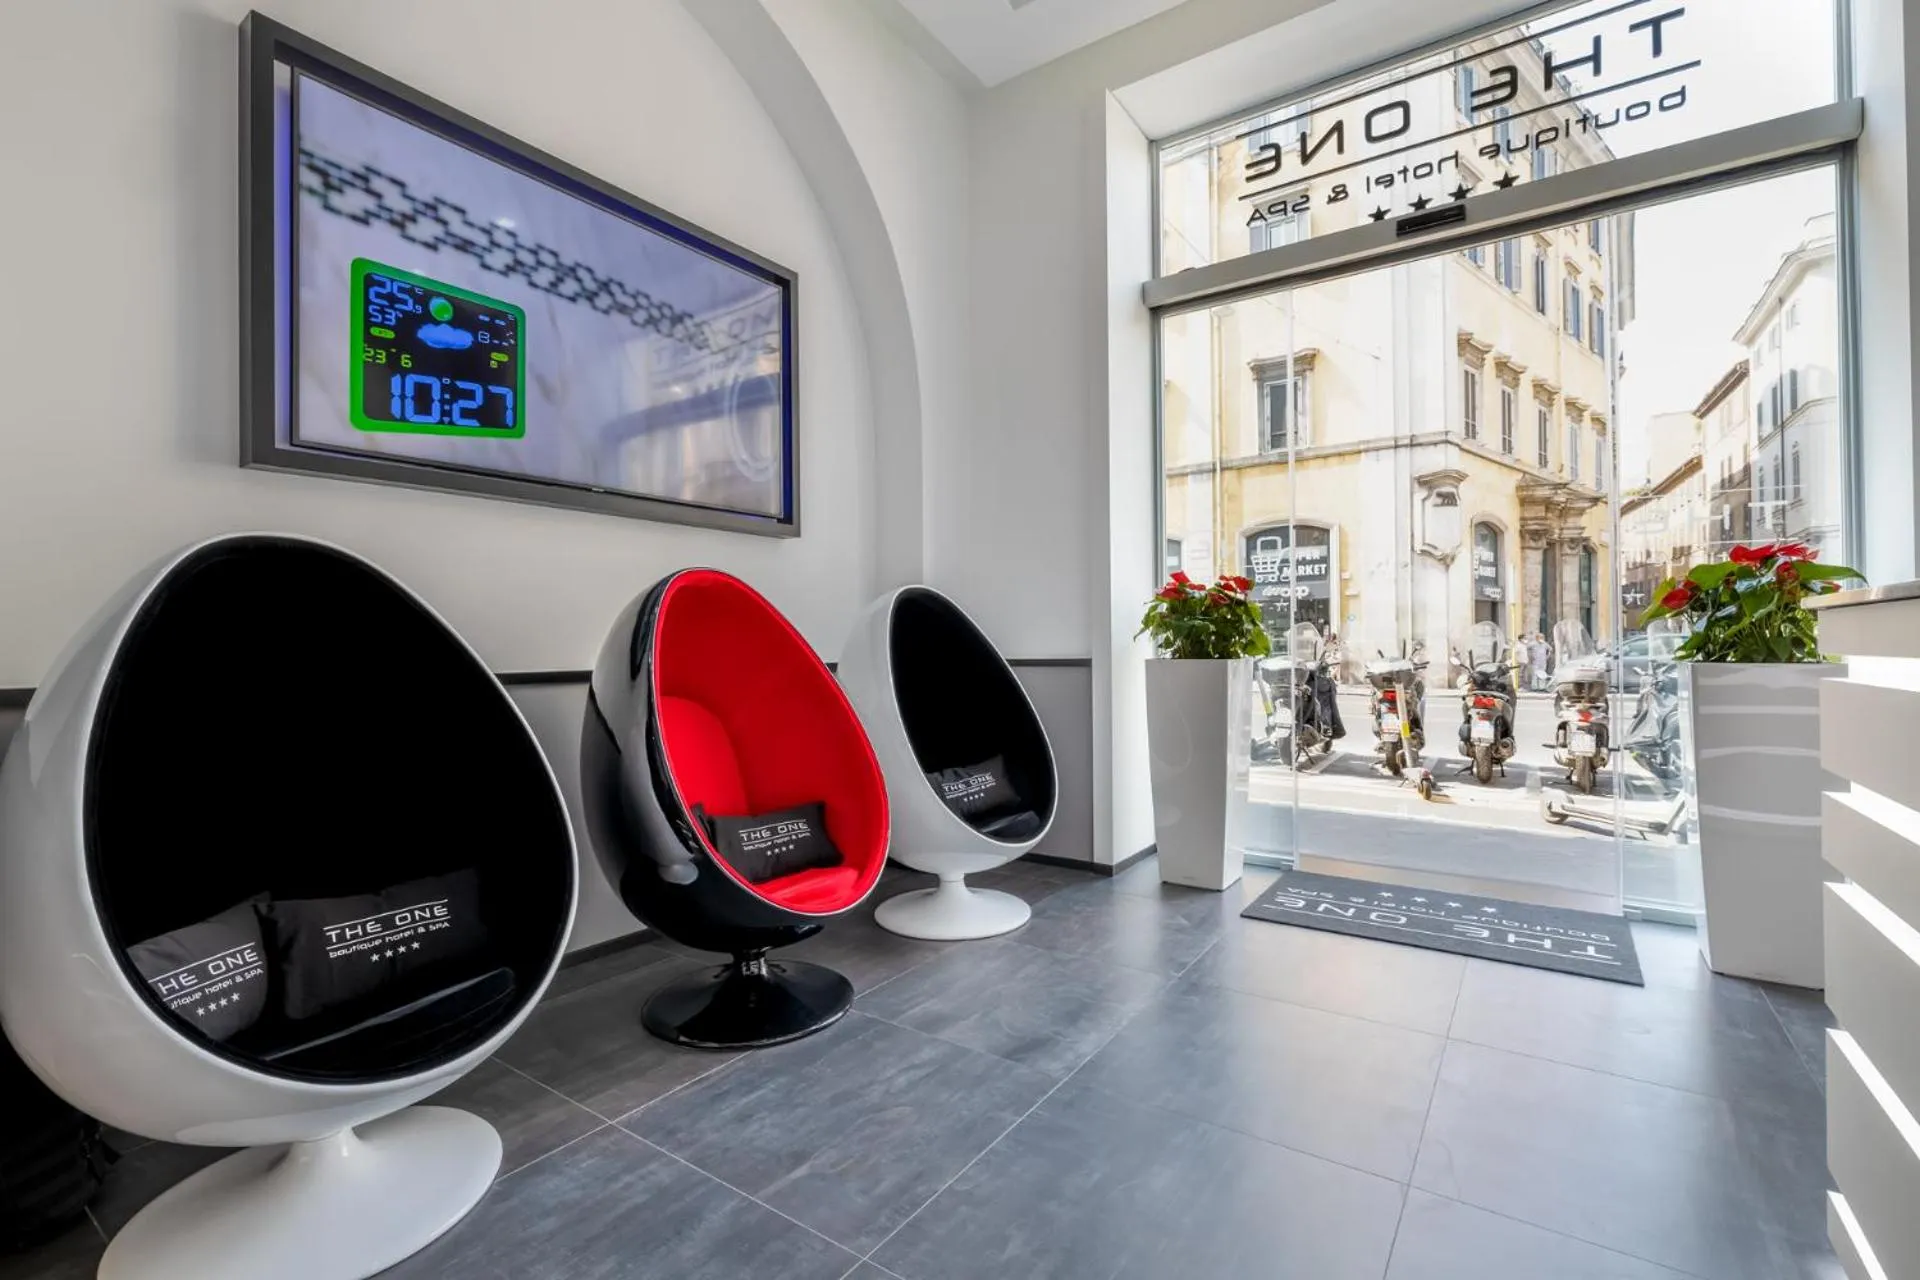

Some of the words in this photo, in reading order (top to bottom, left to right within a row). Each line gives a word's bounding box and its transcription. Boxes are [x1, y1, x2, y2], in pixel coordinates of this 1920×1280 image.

[363, 347, 387, 365] 23
[401, 353, 413, 369] 6
[389, 373, 514, 428] 10:27
[1283, 564, 1327, 576] MRKET
[740, 829, 772, 842] THE
[777, 822, 809, 834] ONE
[326, 921, 383, 943] THE
[394, 905, 449, 926] ONE
[1274, 895, 1408, 925] ONE
[329, 938, 383, 959] boutique
[385, 929, 414, 943] hotel
[1453, 924, 1615, 960] THE
[158, 972, 199, 995] HE
[207, 949, 259, 976] ONE
[171, 991, 203, 1010] tique
[204, 978, 233, 995] hotel
